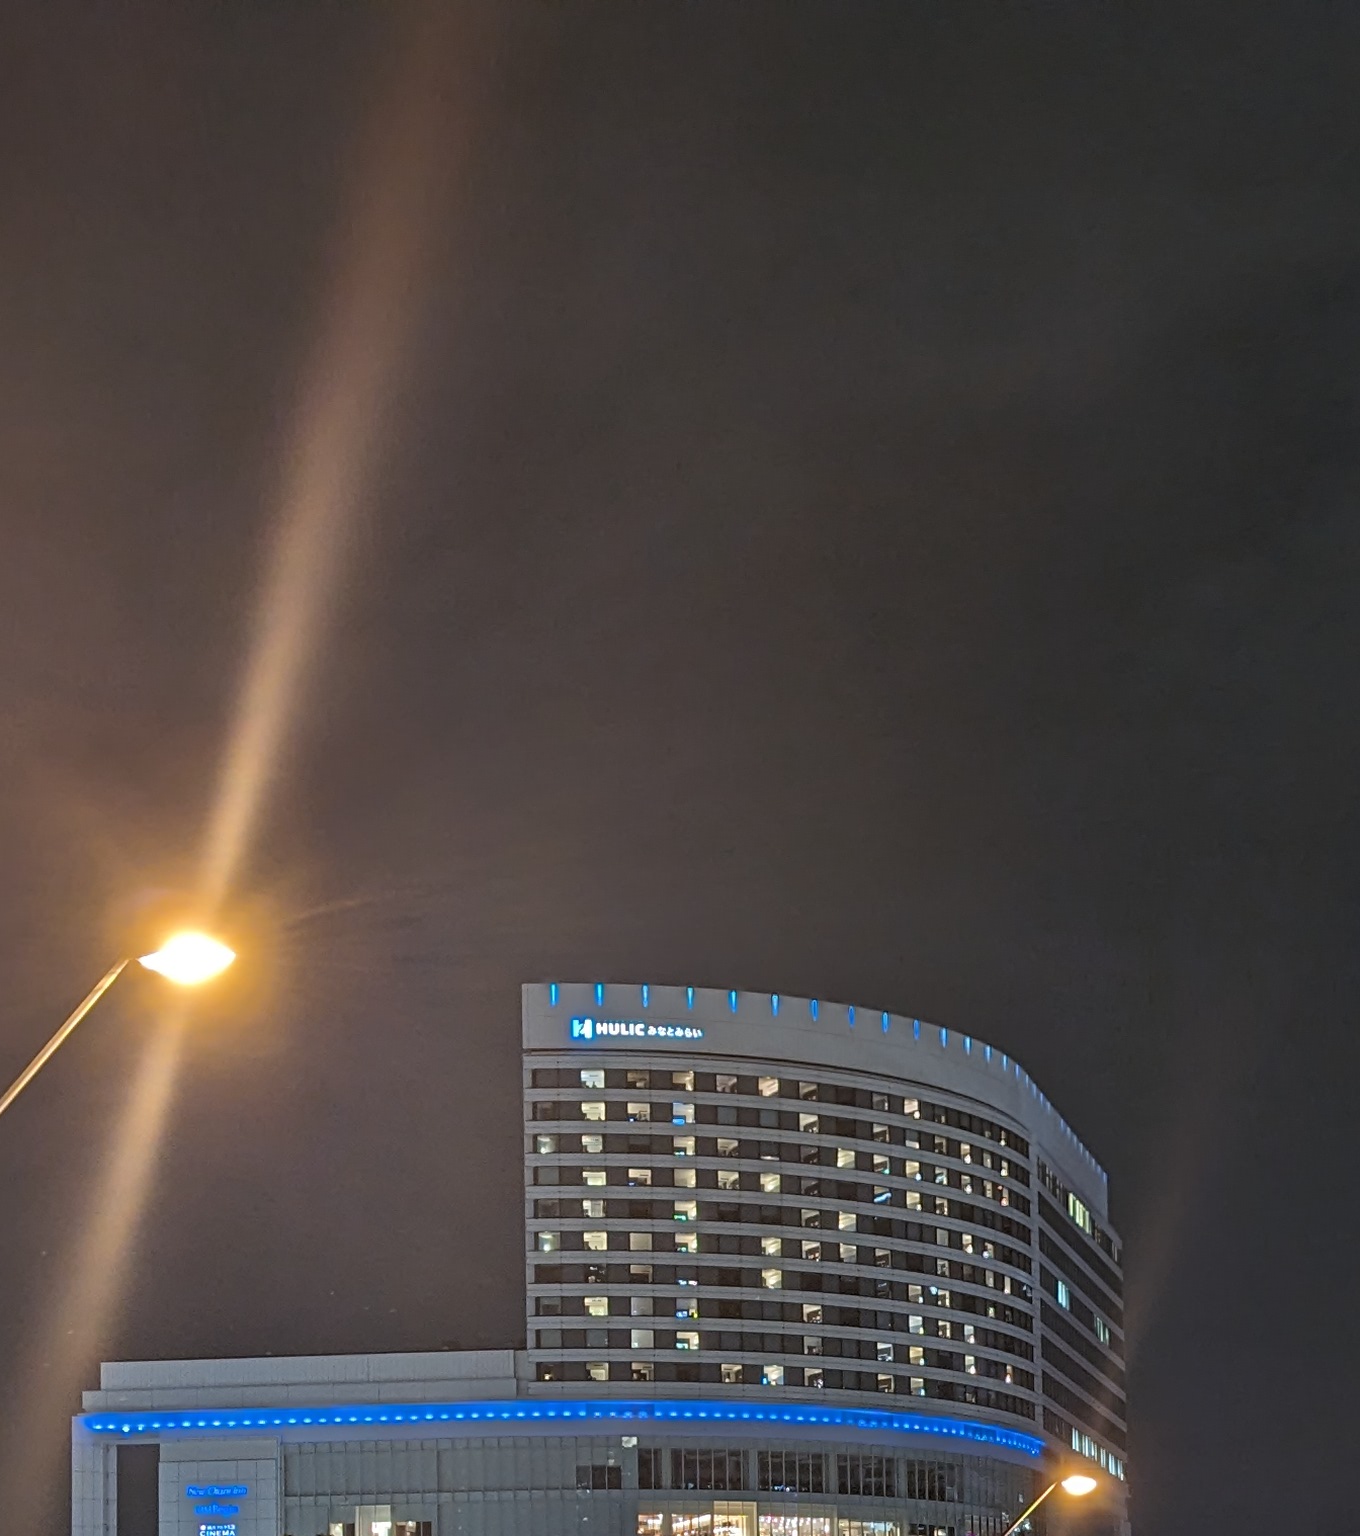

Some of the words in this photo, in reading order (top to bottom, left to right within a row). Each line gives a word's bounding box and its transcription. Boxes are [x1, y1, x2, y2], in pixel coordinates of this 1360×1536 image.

[596, 1022, 645, 1036] HULIC
[647, 1025, 703, 1038] みなとみらい
